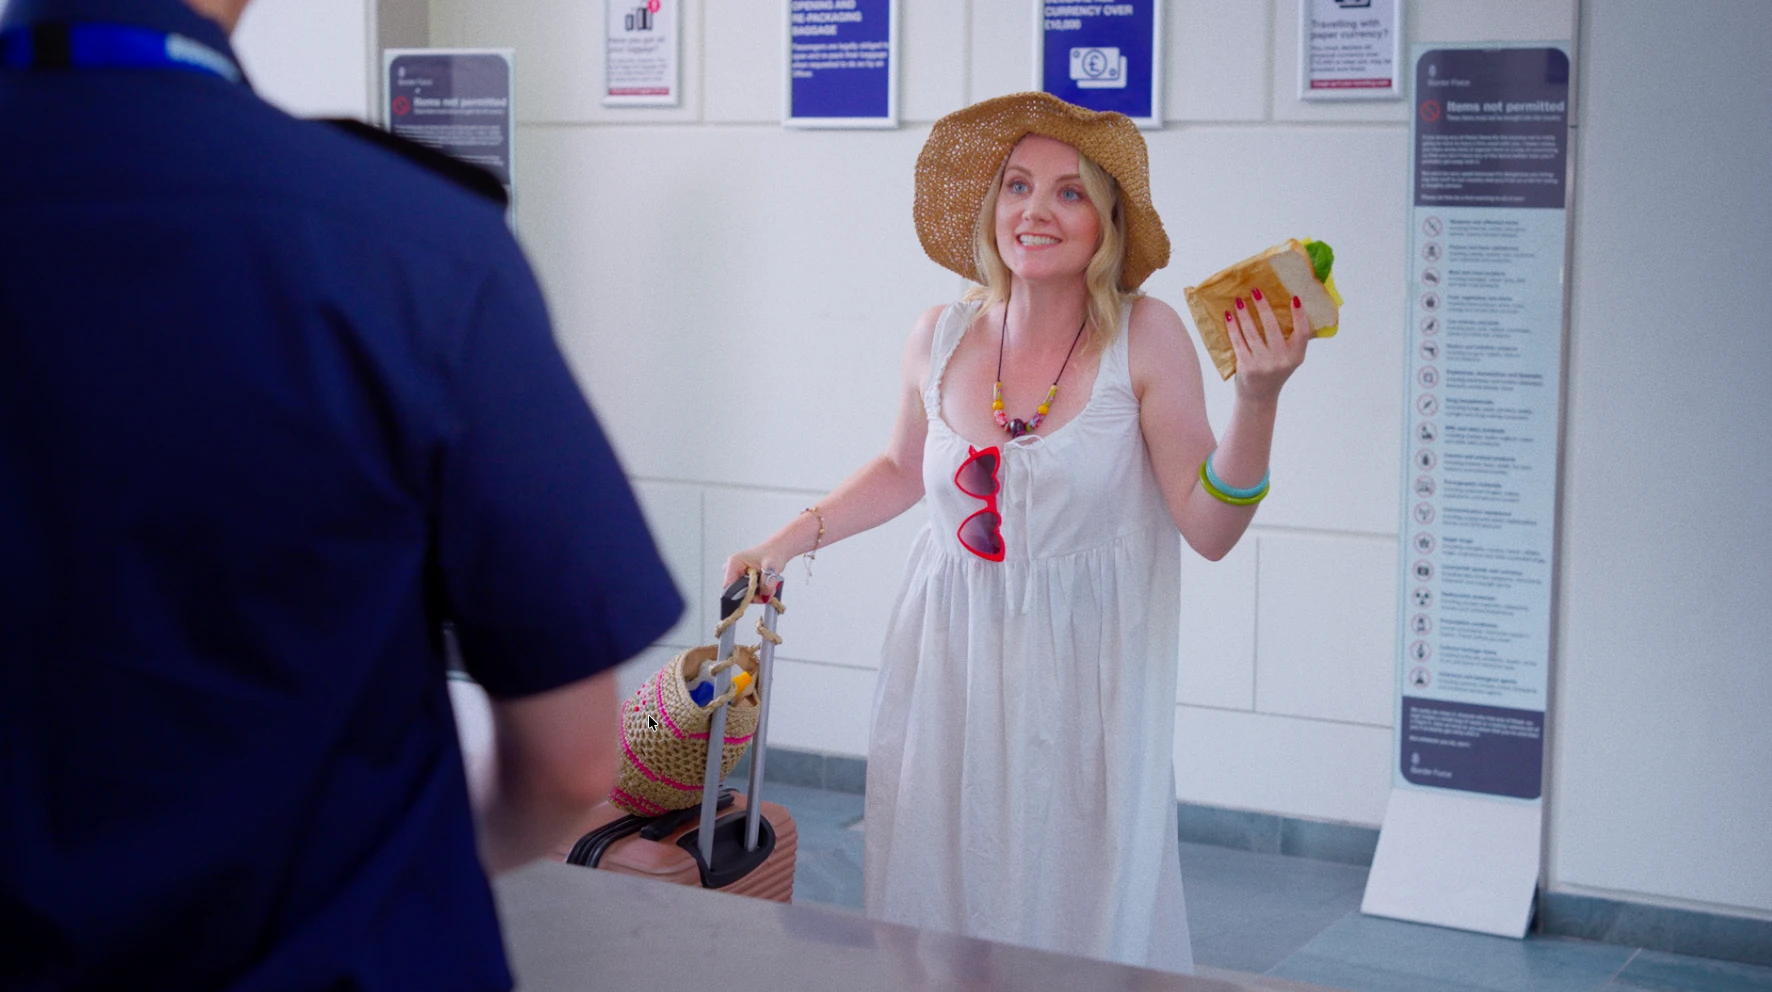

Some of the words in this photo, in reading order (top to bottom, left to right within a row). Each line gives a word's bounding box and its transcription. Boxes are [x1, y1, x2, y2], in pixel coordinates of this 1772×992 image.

[835, 0, 857, 10] AND
[1044, 5, 1101, 17] CURRENCY
[1102, 4, 1133, 16] OVER
[791, 24, 838, 36] BAGGAGE
[1044, 18, 1082, 30] £10,000
[1310, 19, 1357, 30] Travelling
[1360, 18, 1380, 27] with
[1309, 32, 1337, 41] paper
[1340, 28, 1389, 40] currency?
[1446, 101, 1480, 113] Items
[1482, 101, 1503, 113] not
[1505, 101, 1565, 114] permitted
